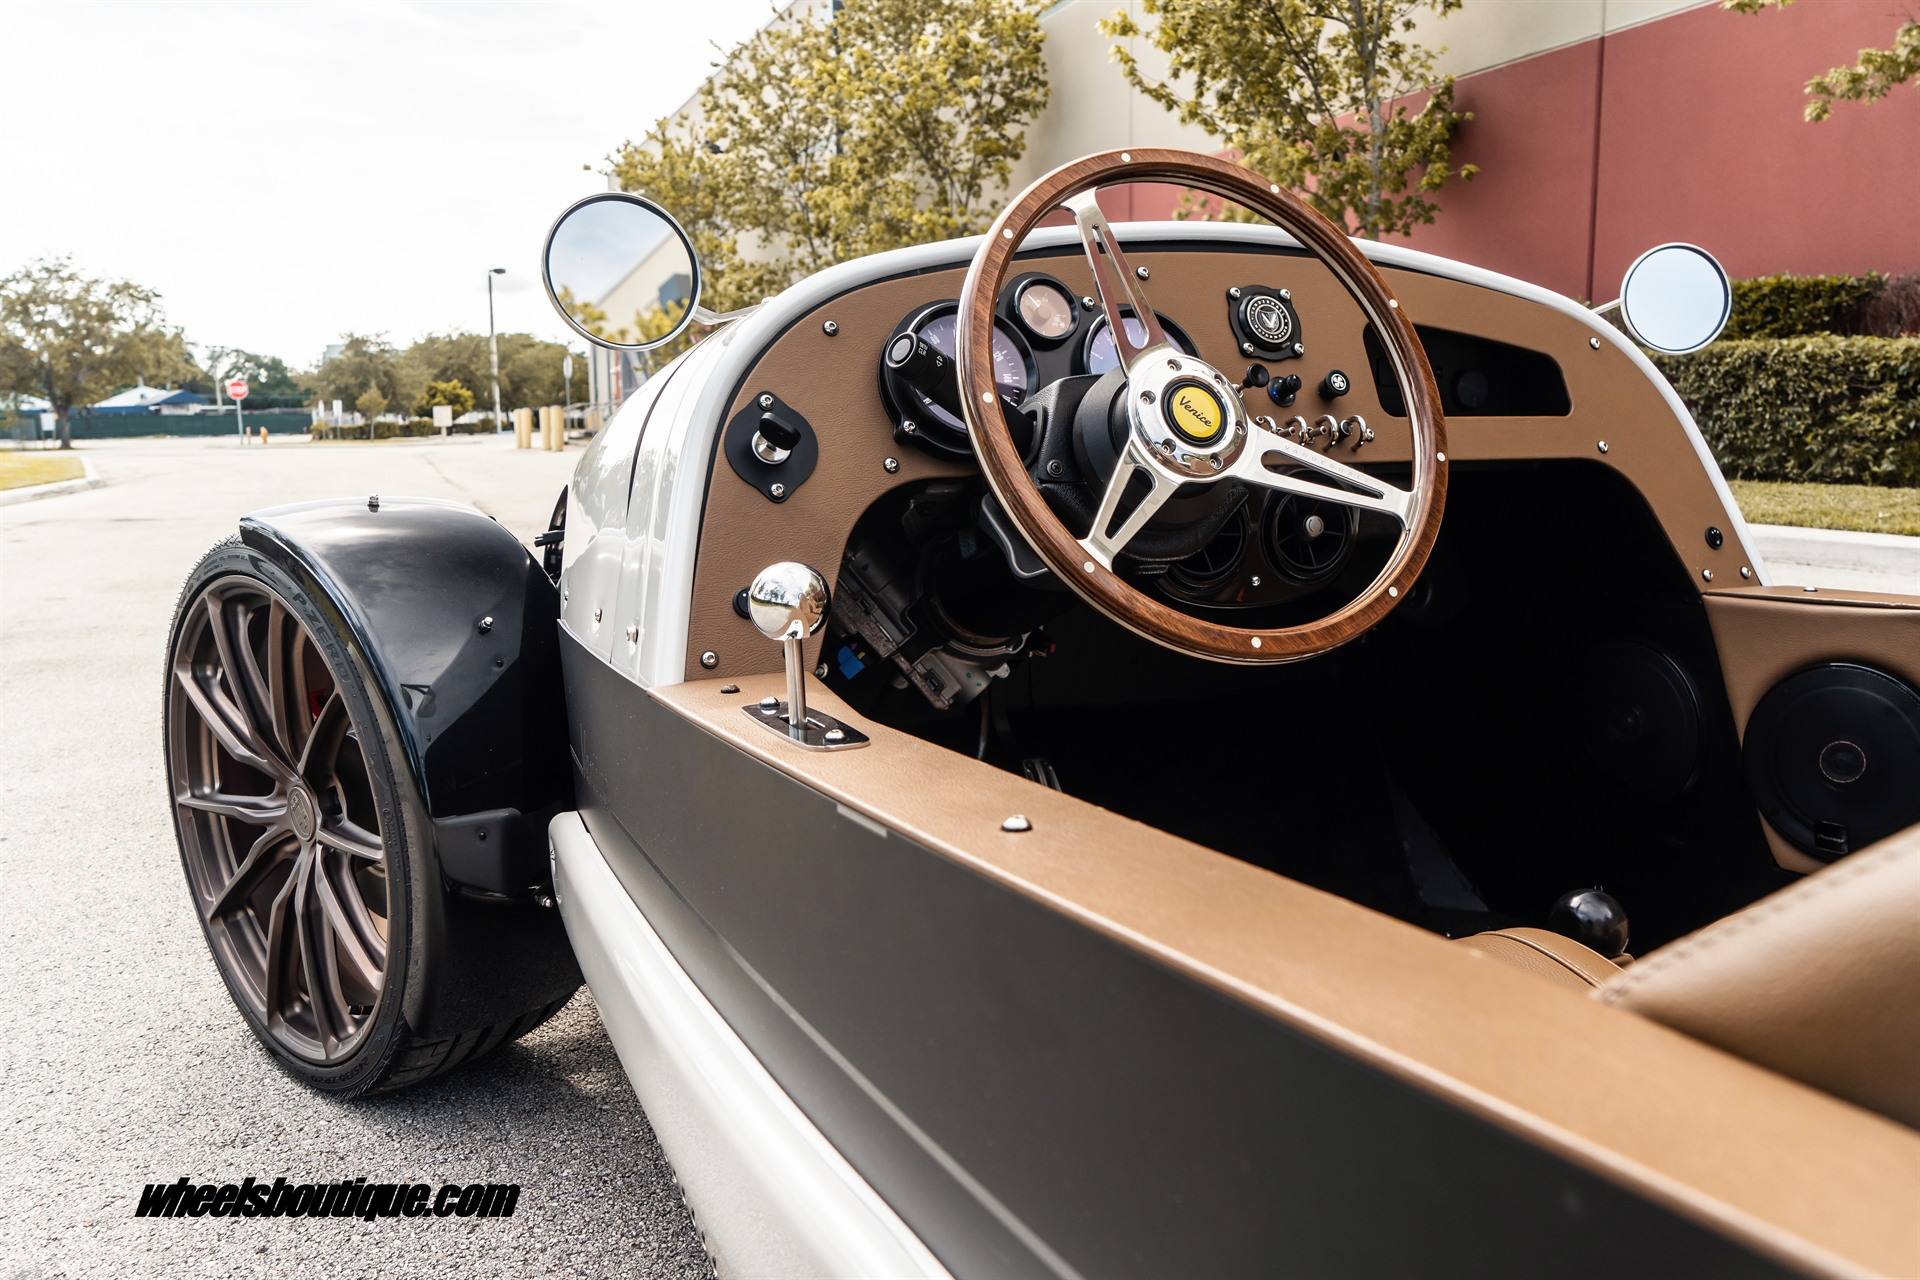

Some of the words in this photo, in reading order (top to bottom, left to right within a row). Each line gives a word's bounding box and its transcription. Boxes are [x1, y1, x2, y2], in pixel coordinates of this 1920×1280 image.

[993, 350, 1004, 362] 120
[1002, 373, 1013, 383] 140
[1179, 395, 1212, 428] Venice
[1284, 445, 1370, 483] VANDERHALL
[305, 609, 351, 684] ZERO
[340, 1056, 370, 1081] 245/30
